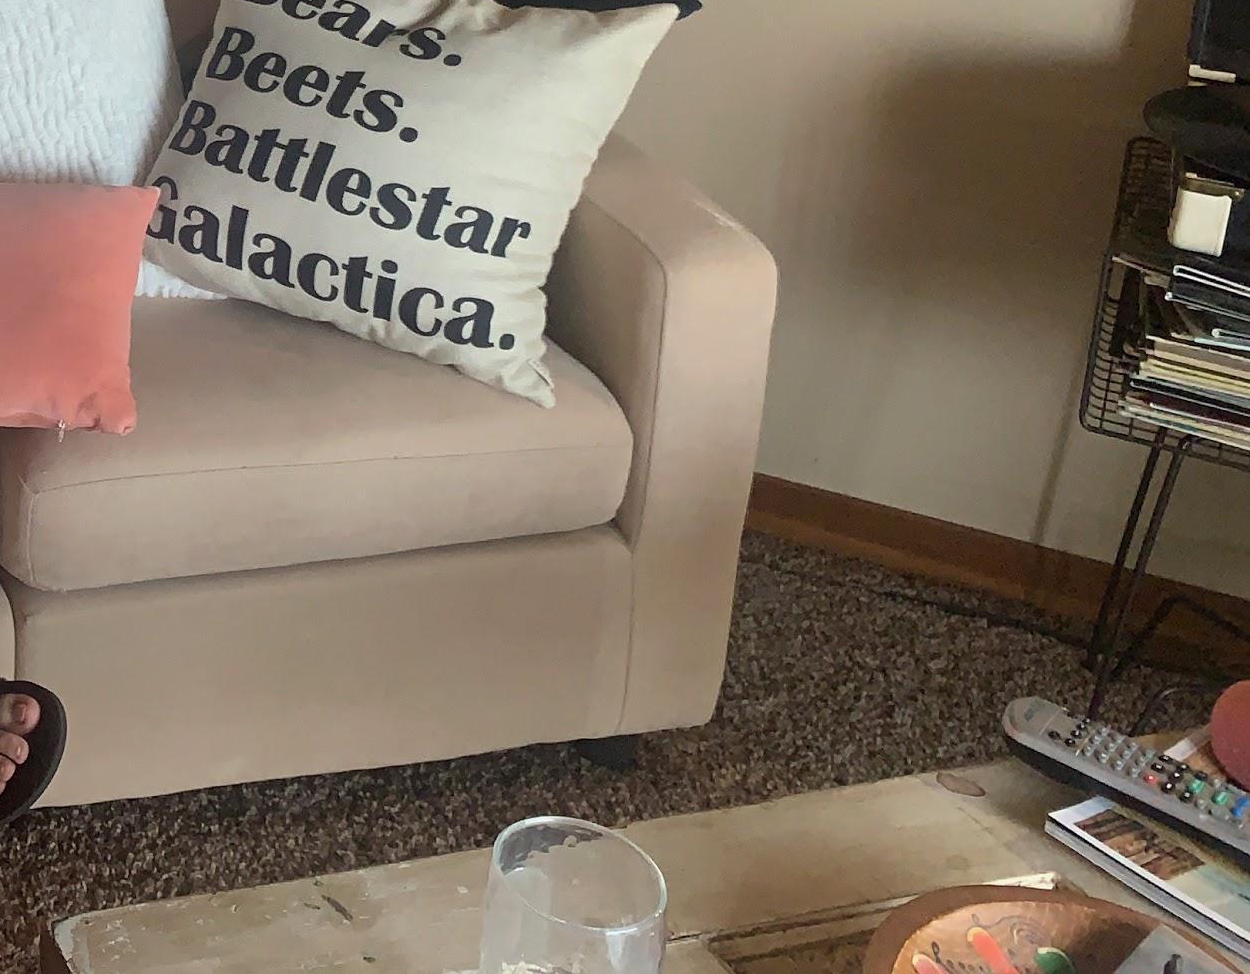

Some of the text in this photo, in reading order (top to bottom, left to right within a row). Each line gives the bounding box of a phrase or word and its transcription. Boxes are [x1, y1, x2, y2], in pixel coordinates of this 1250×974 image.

[205, 26, 419, 143] Beets.
[168, 99, 531, 259] Battlestar
[145, 175, 516, 351] Galactica.
